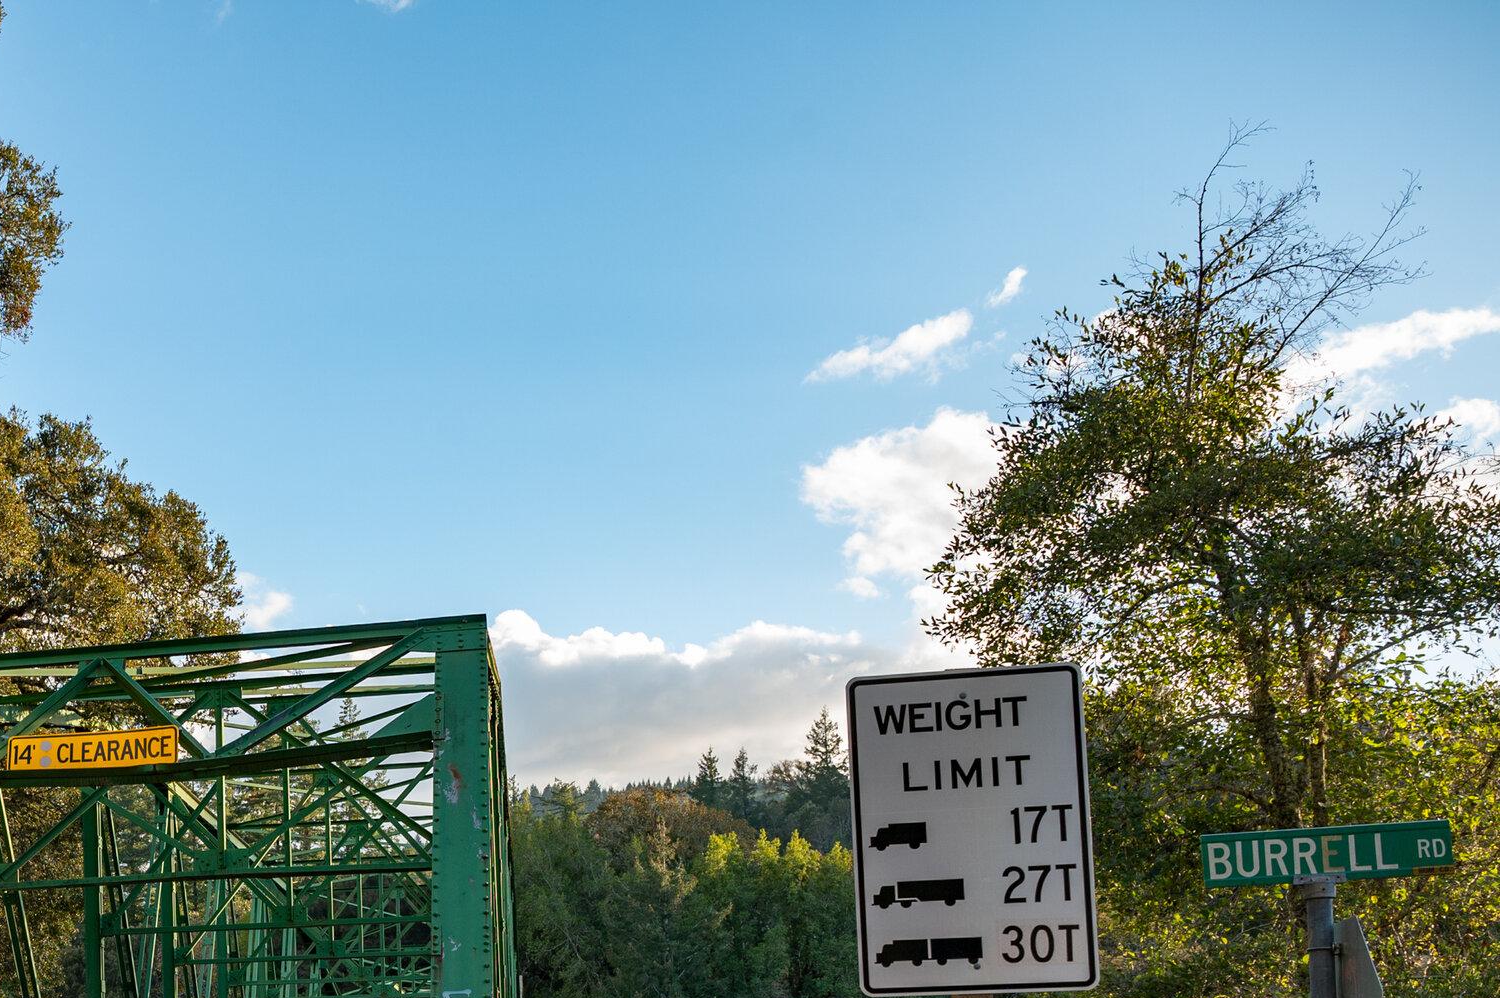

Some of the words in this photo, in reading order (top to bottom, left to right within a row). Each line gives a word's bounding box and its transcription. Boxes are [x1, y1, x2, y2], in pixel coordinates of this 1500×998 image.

[873, 695, 1028, 736] WEIGHT
[57, 735, 172, 763] CLEARANCE
[902, 755, 1031, 792] LIMIT
[1010, 804, 1073, 845] 17T
[1207, 832, 1399, 881] BURRELL
[1417, 838, 1447, 859] RD
[1002, 864, 1077, 904] 27T
[1001, 924, 1080, 964] 30T
